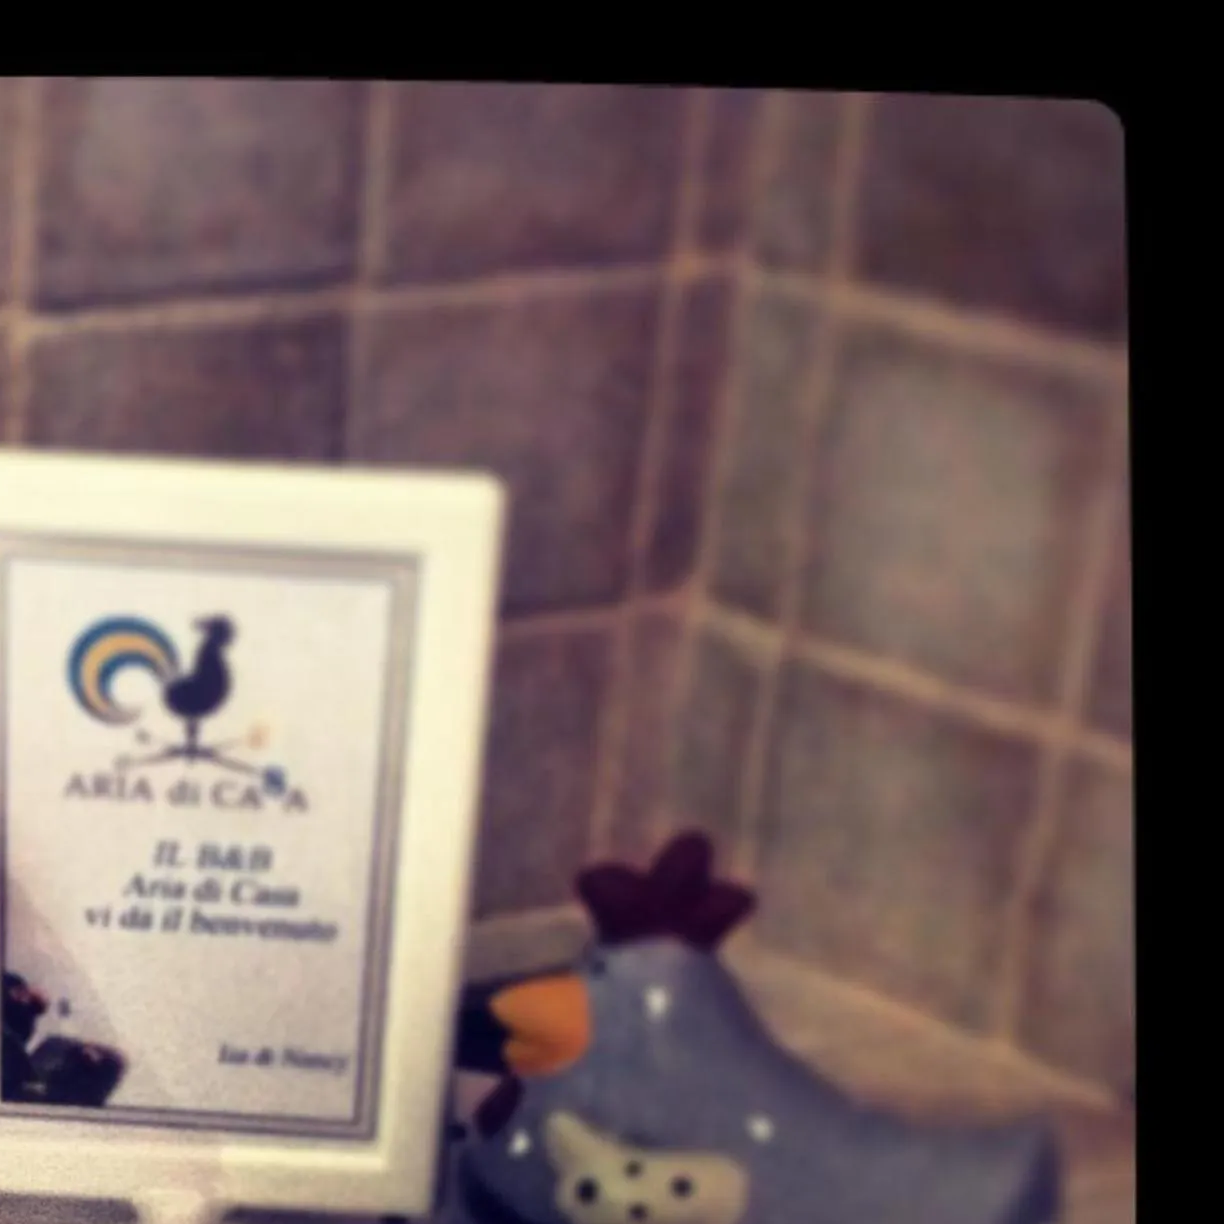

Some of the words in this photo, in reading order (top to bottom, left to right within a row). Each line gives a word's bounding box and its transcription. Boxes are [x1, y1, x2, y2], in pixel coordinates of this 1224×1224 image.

[64, 772, 153, 803] ARIA
[166, 777, 201, 808] di
[195, 842, 276, 873] B&B
[123, 872, 188, 900] Aria
[191, 876, 224, 904] di
[229, 878, 301, 908] Casa
[84, 904, 113, 928] vi
[160, 904, 184, 933] il
